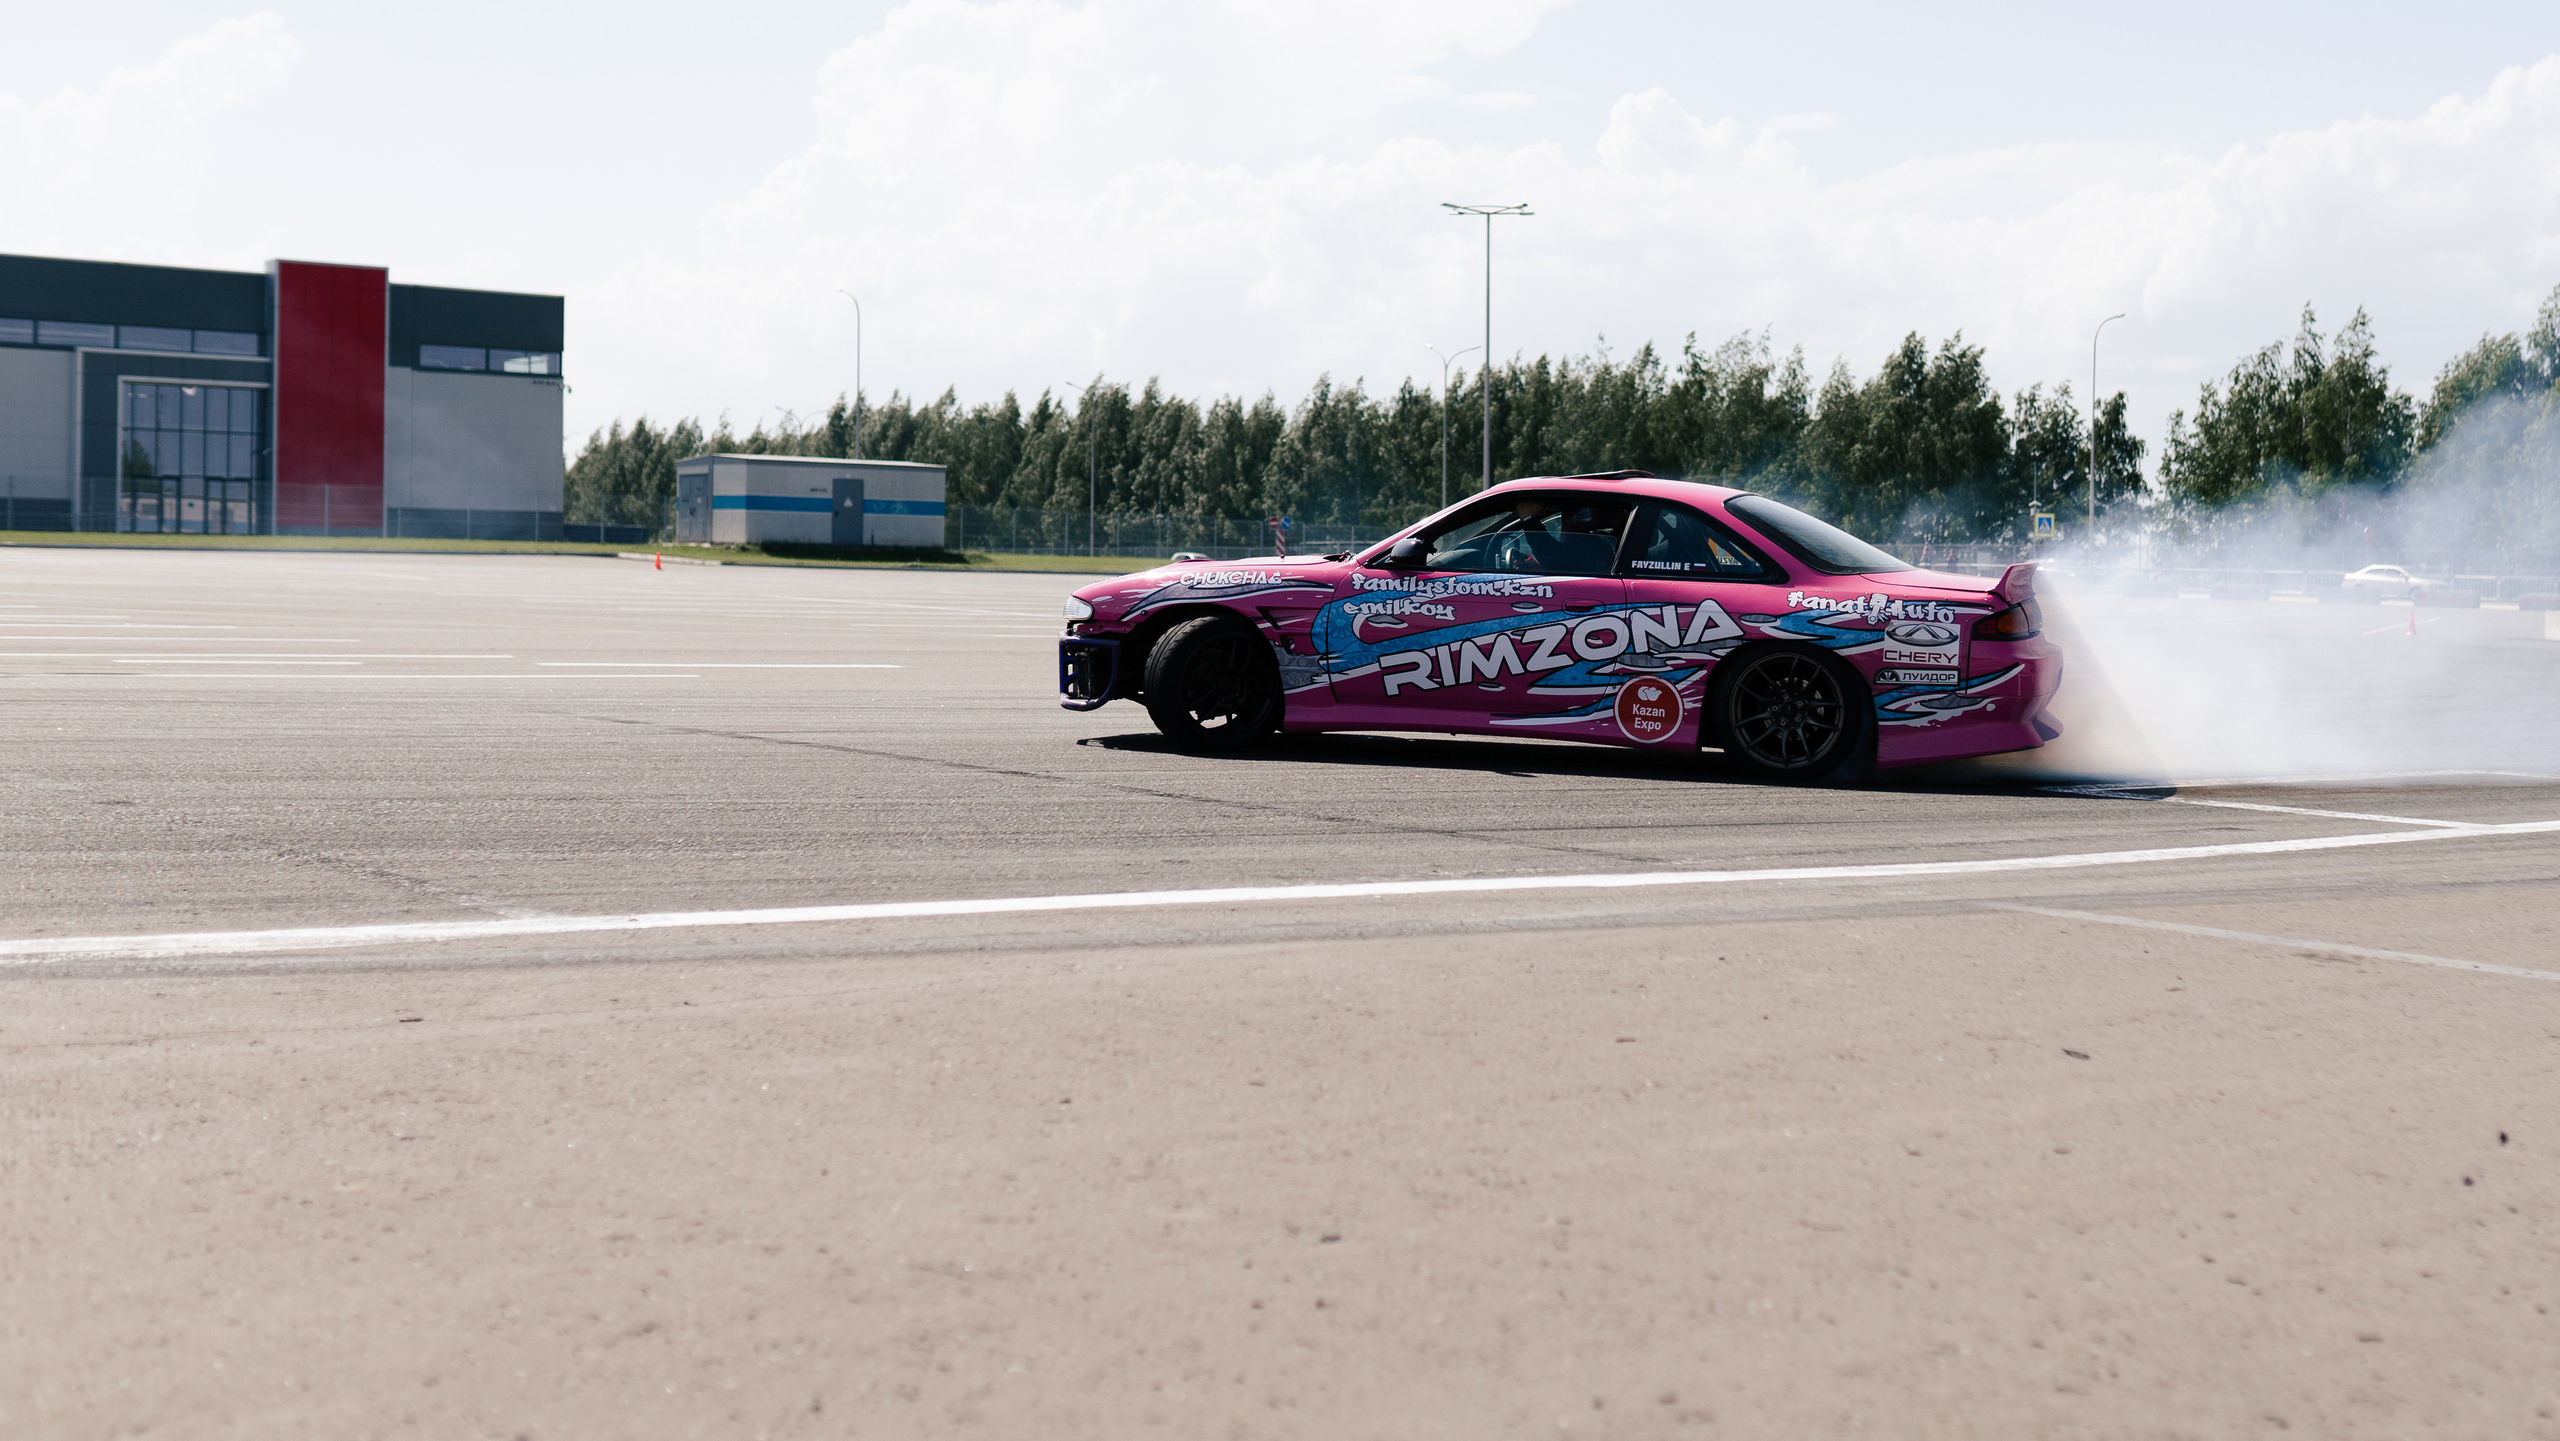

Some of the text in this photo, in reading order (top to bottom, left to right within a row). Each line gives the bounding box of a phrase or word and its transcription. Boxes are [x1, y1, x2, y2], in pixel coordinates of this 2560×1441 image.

[1631, 560, 1691, 571] FAYZULLIN E
[1886, 599, 1955, 624] Auto
[1379, 599, 1745, 696] RIMZONA
[1884, 650, 1958, 664] CHERY
[1902, 672, 1956, 683] ЛУИДОР
[1632, 703, 1666, 718] Kazan
[1634, 717, 1662, 733] Expo
